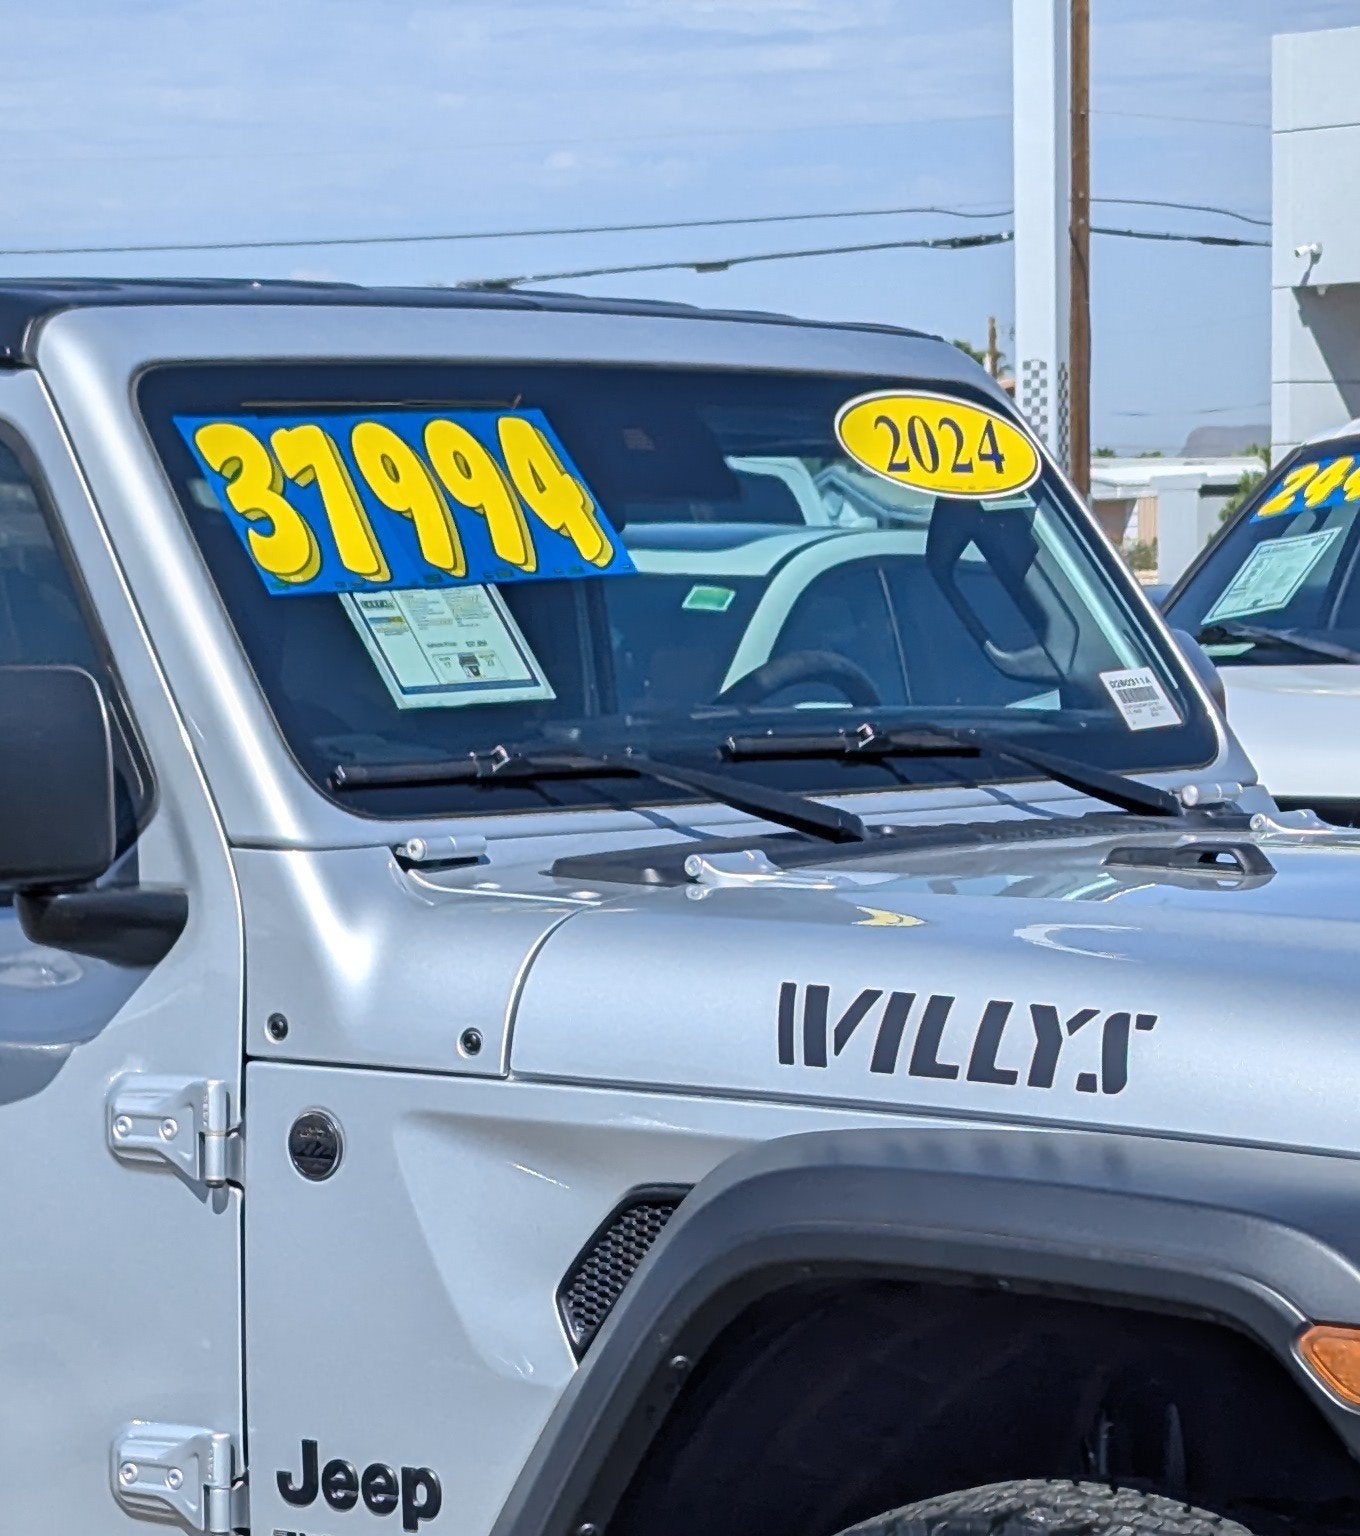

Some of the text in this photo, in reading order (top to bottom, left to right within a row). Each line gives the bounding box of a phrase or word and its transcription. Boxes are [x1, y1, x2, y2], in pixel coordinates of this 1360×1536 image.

[873, 413, 1005, 476] 2024
[194, 415, 615, 583] 37994
[776, 981, 1158, 1095] WILLYS
[275, 1438, 443, 1534] Jeep
